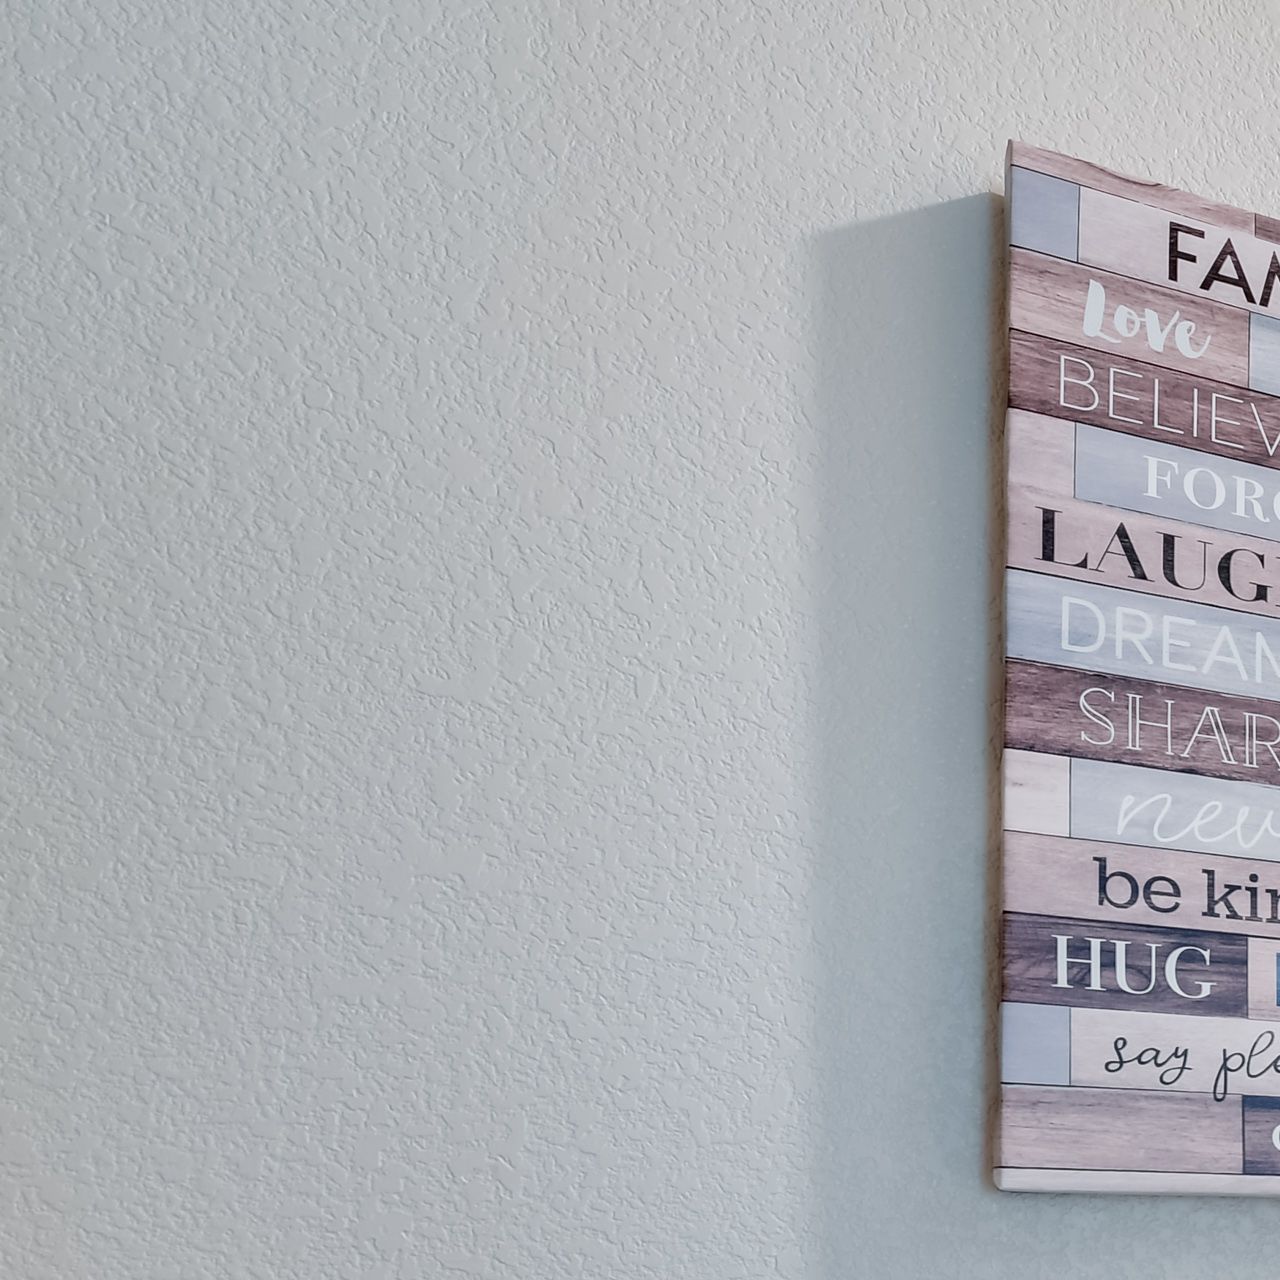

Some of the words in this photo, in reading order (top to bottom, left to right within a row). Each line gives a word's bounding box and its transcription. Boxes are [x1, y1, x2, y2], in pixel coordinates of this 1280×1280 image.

[1082, 278, 1213, 360] Love
[1091, 856, 1181, 913] be
[1050, 933, 1213, 1000] HUG
[1103, 1030, 1193, 1085] say
